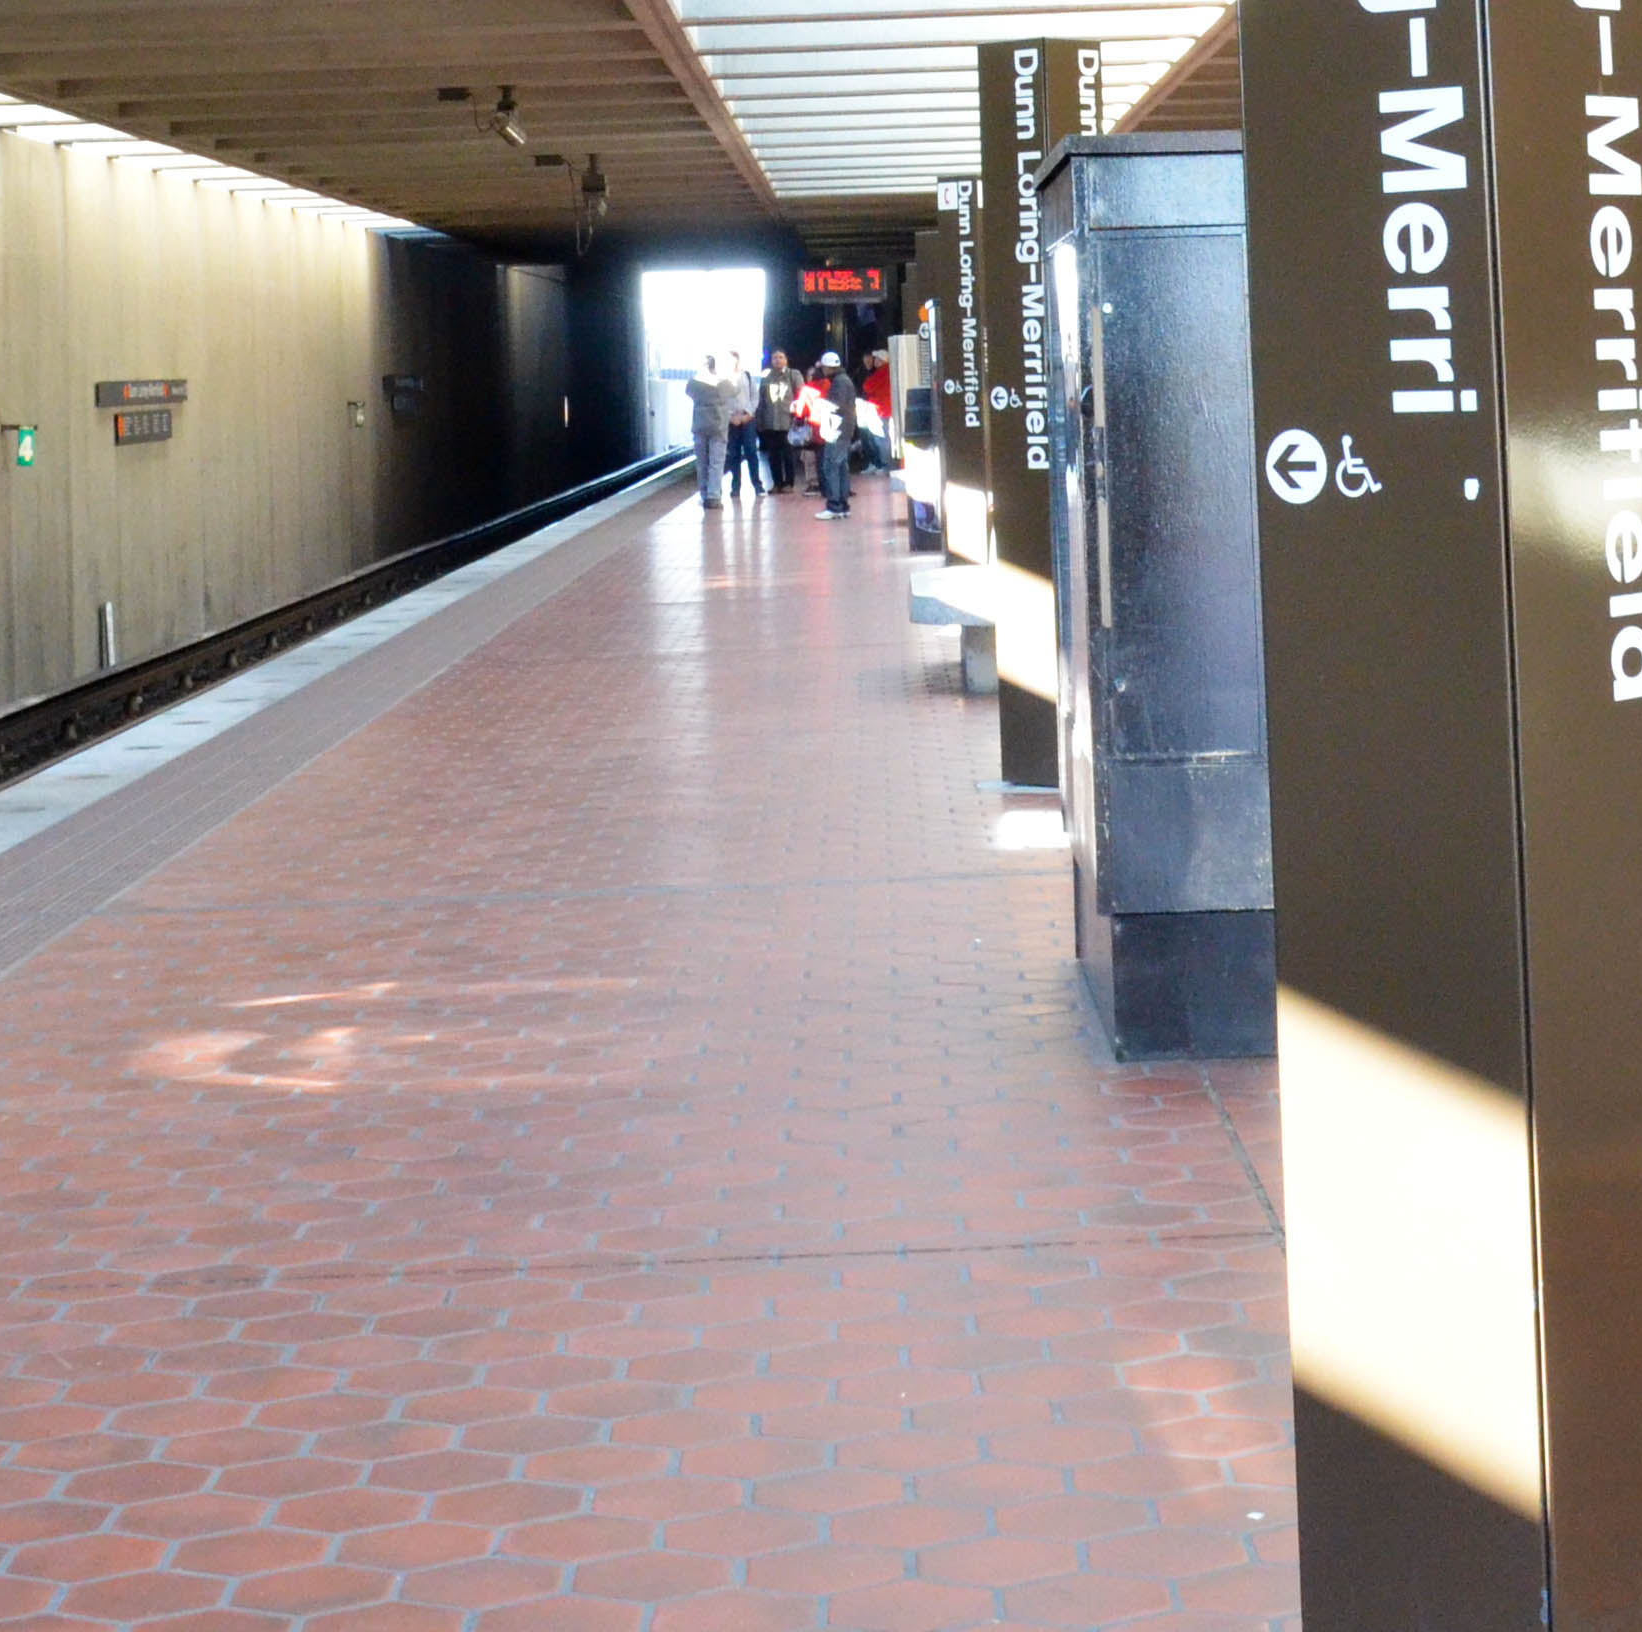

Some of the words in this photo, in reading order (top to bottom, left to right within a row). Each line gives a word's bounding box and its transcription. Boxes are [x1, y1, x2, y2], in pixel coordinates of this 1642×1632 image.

[1014, 48, 1038, 140] Dunn
[1078, 49, 1098, 136] Dunn
[958, 181, 972, 235] Dunn
[19, 435, 33, 462] 4
